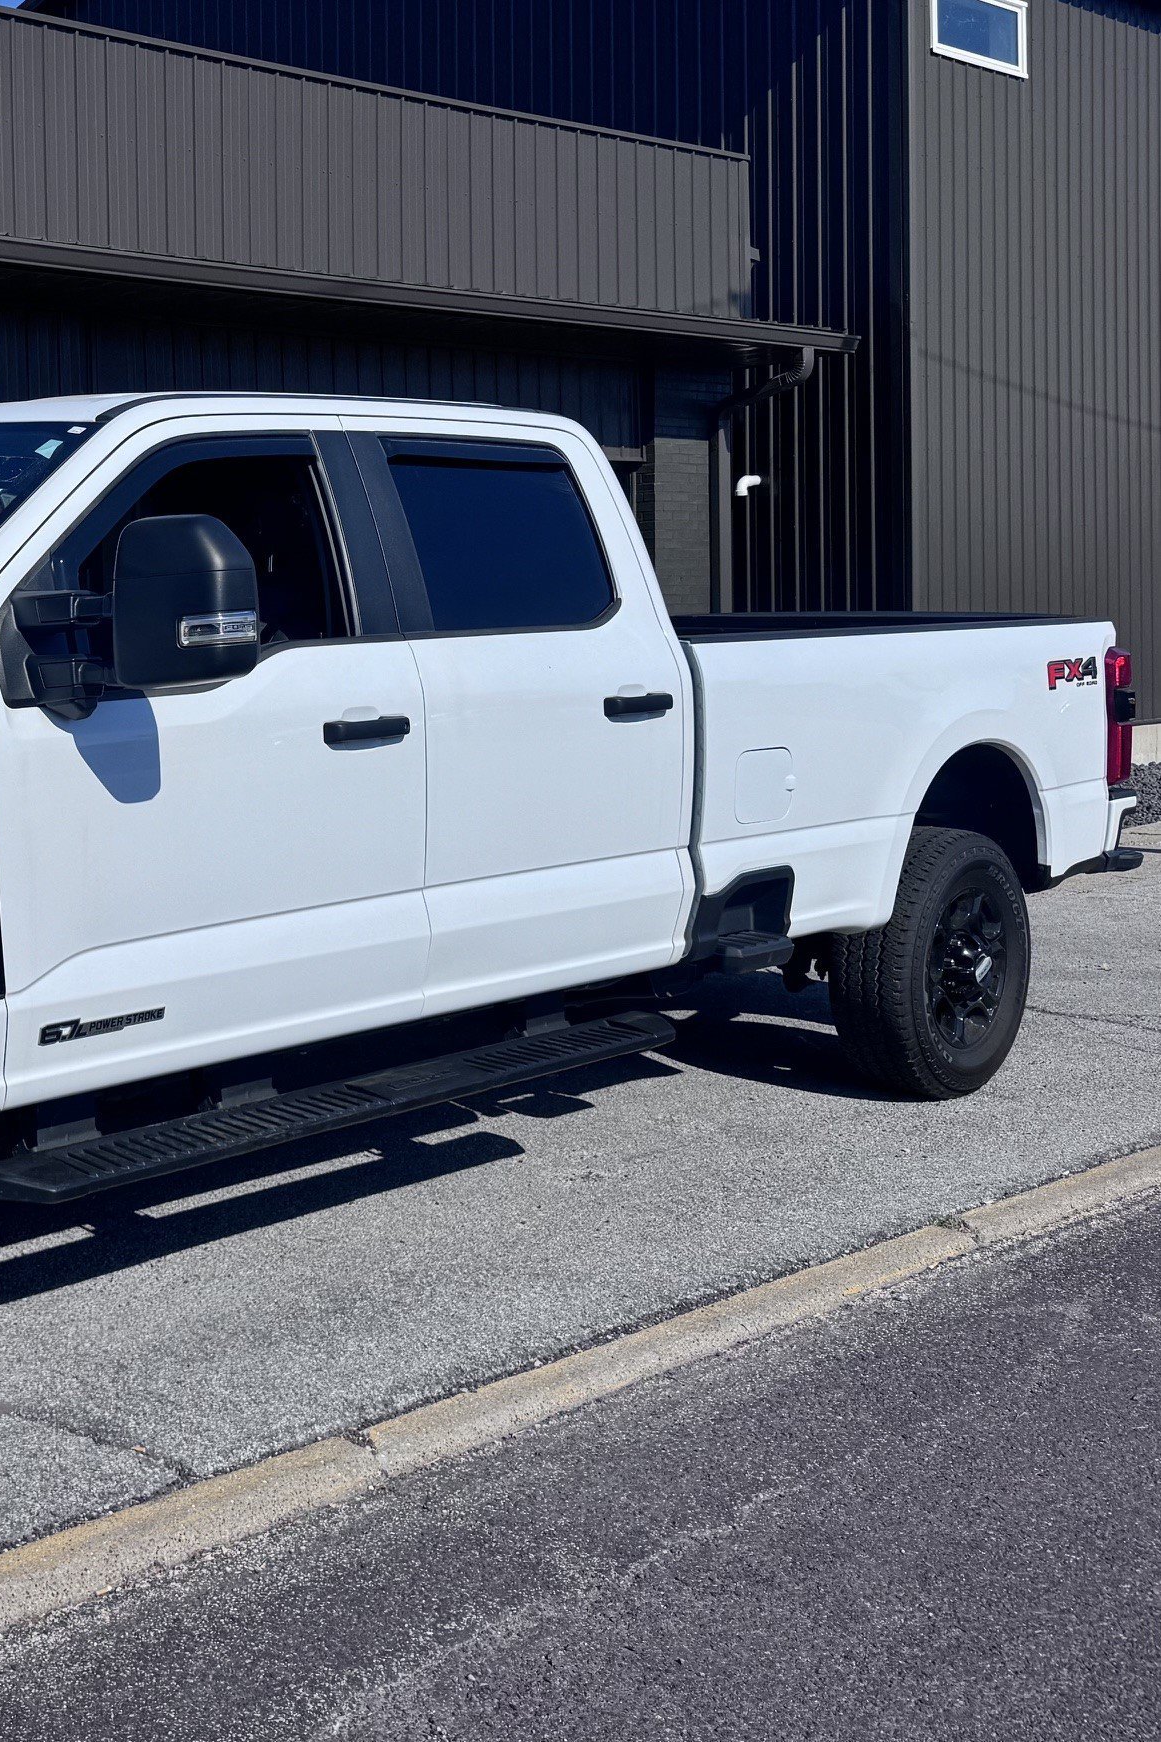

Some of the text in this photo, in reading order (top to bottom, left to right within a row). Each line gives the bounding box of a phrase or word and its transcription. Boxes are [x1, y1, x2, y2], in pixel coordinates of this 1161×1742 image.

[1047, 656, 1098, 691] FX4
[37, 1018, 88, 1046] 6.7L
[89, 1018, 124, 1032] POWER
[125, 1007, 165, 1025] STROKE
